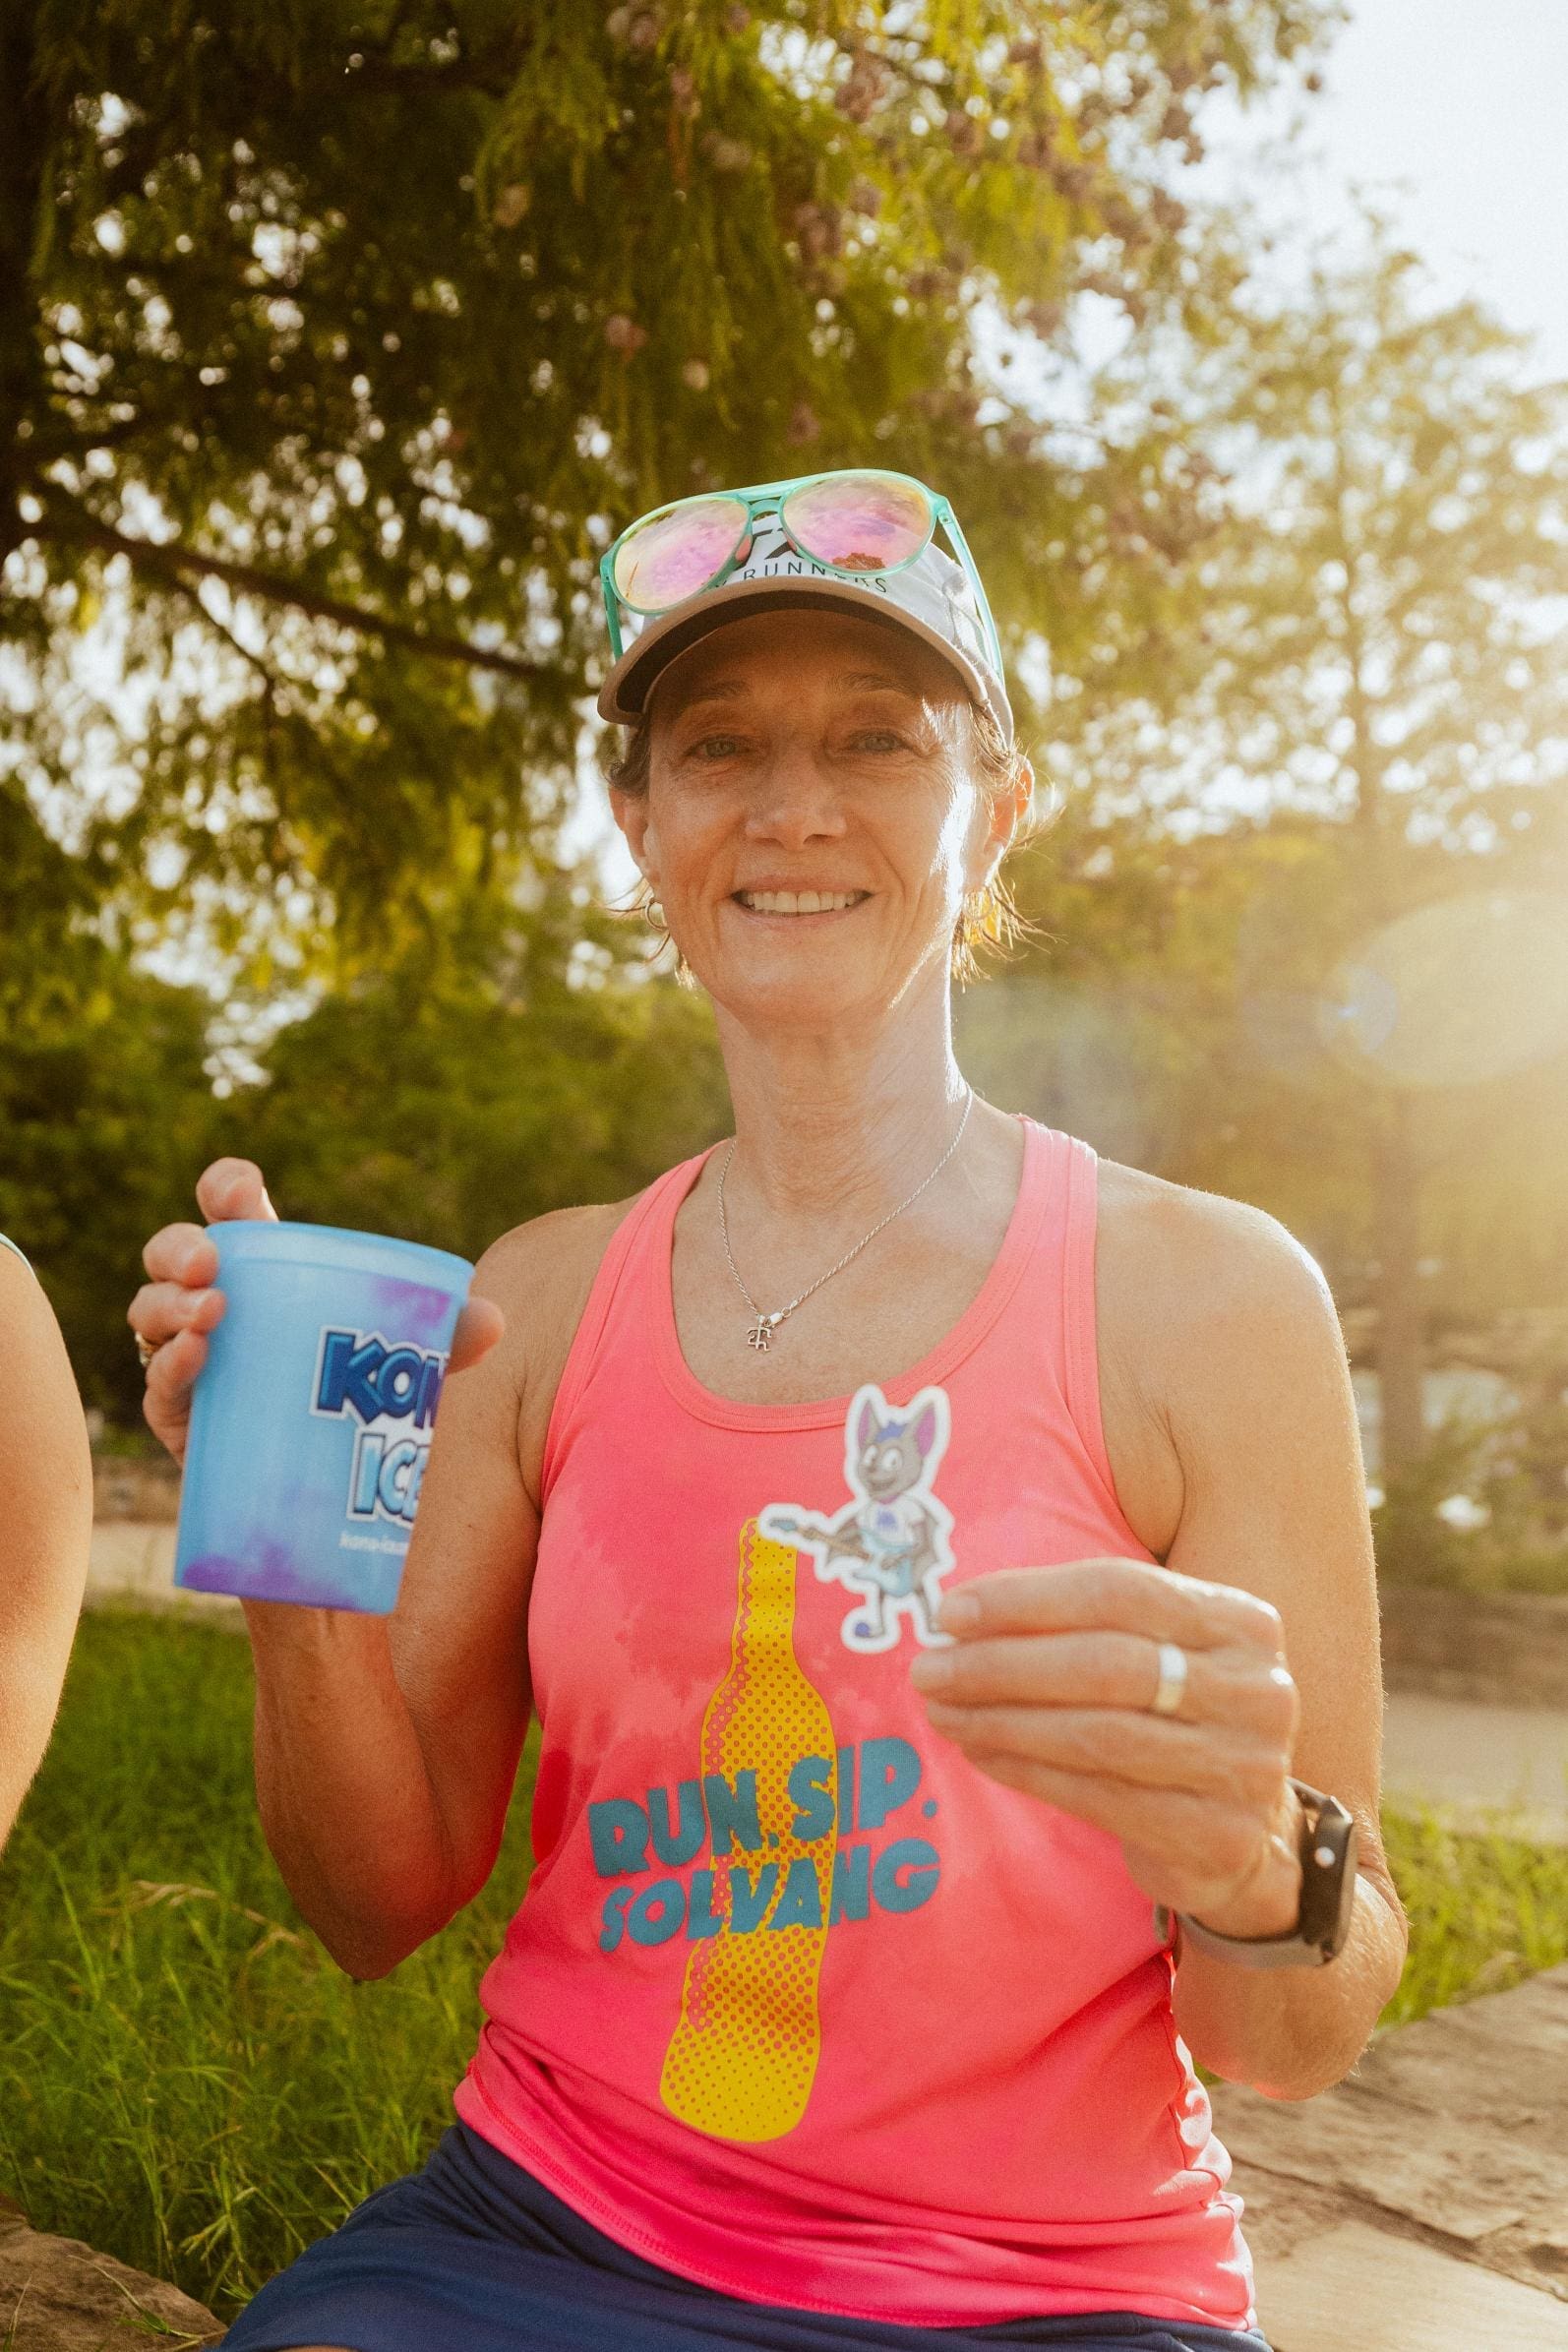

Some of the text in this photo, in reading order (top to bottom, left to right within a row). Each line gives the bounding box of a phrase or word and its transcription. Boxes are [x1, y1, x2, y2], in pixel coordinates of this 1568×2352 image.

[587, 1737, 937, 1877] RUN. SIP.
[598, 1838, 940, 1953] SOLVANG
